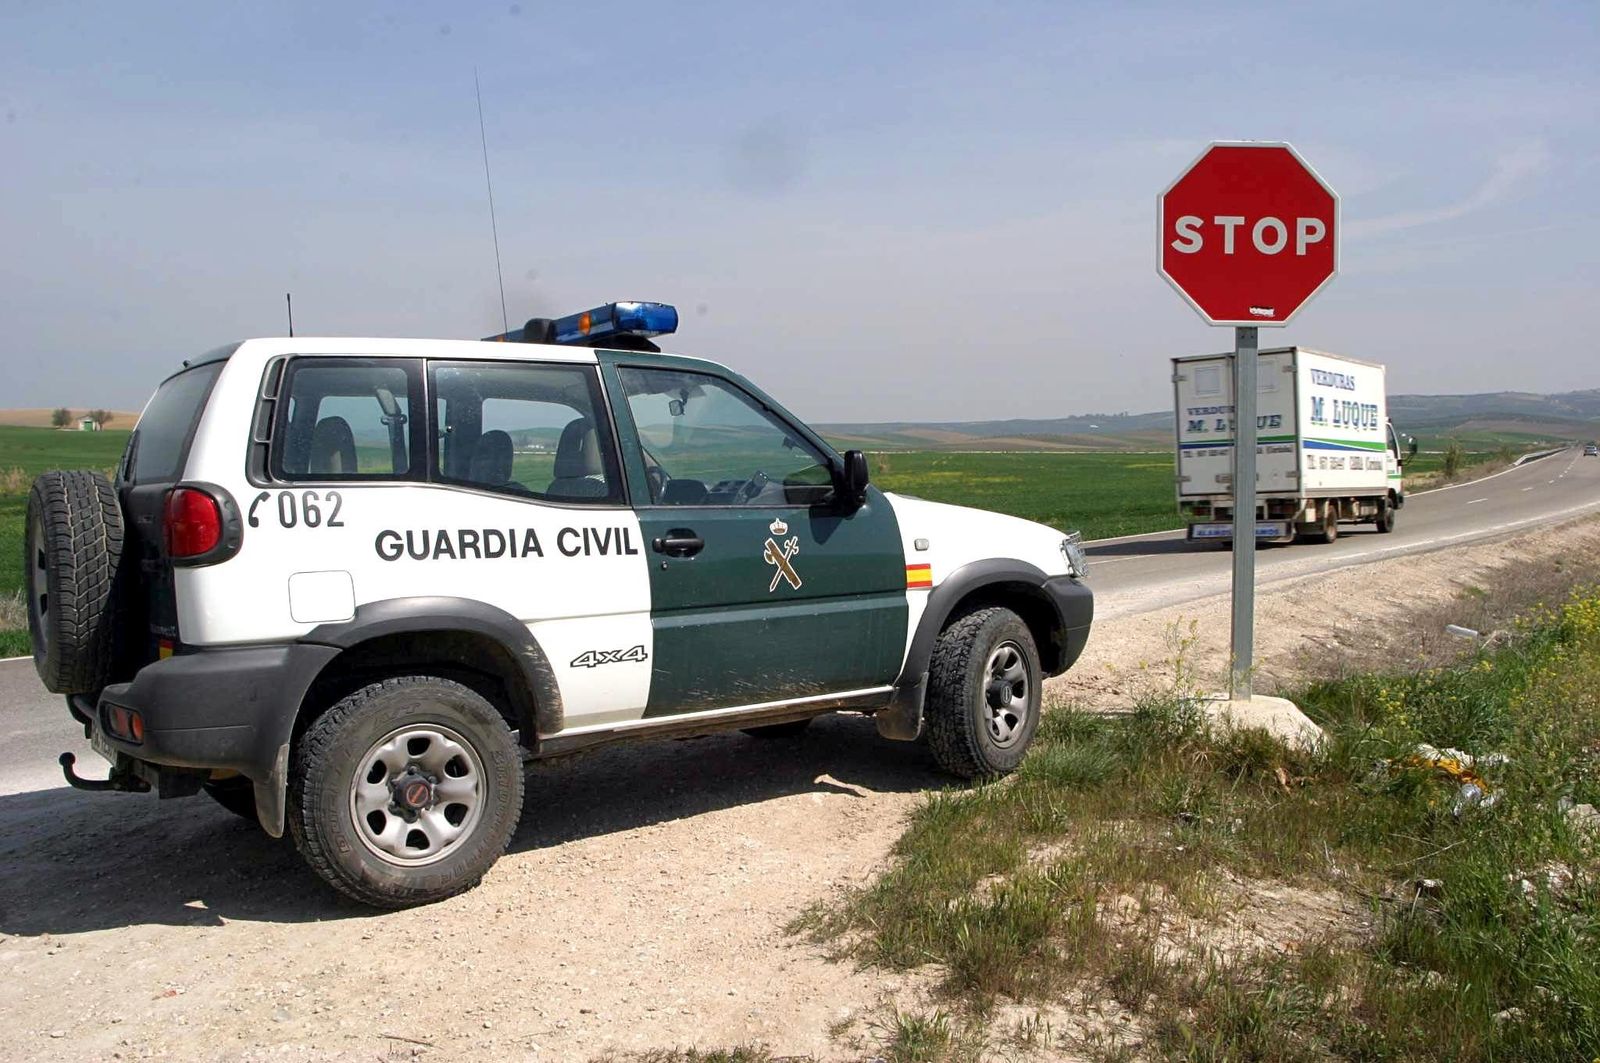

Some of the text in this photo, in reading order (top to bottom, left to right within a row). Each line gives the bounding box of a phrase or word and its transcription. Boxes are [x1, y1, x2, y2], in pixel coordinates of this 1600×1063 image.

[1171, 215, 1326, 256] STOP
[1310, 368, 1356, 391] VERDURAS
[1187, 405, 1236, 416] VERDUR
[1214, 414, 1282, 433] LUE
[1333, 399, 1378, 431] LUQUE
[278, 490, 344, 529] 062
[374, 527, 639, 562] GUARDIA CIVIL
